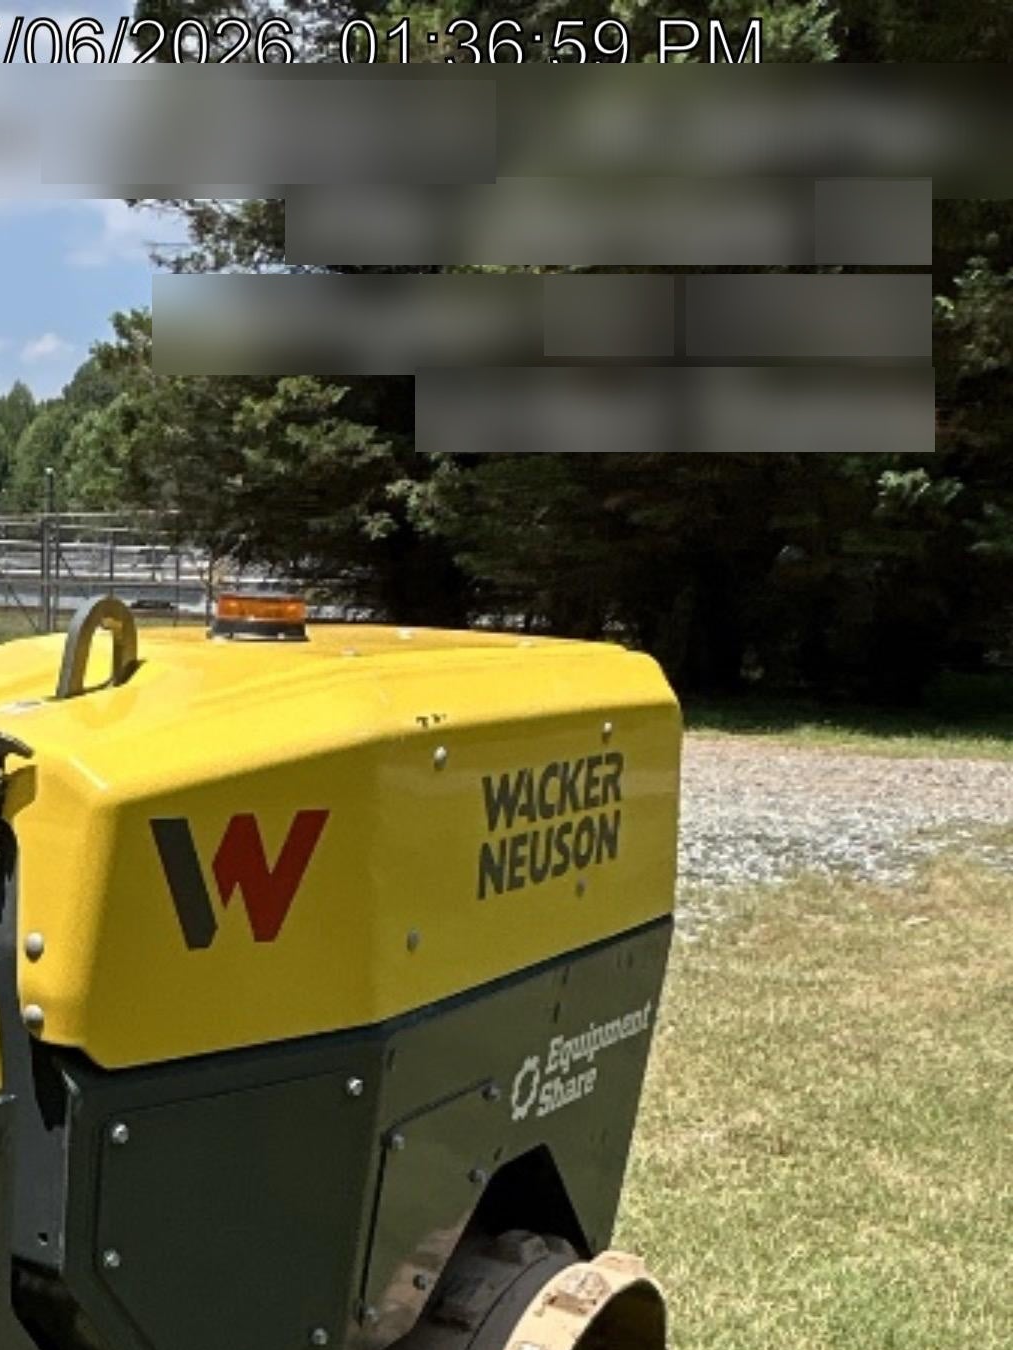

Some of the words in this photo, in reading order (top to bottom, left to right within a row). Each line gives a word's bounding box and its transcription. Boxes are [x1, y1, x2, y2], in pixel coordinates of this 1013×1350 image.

[482, 752, 624, 832] WACKER
[478, 809, 621, 900] NEUSON
[544, 1000, 652, 1075] Equipment
[535, 1067, 598, 1117] Share
